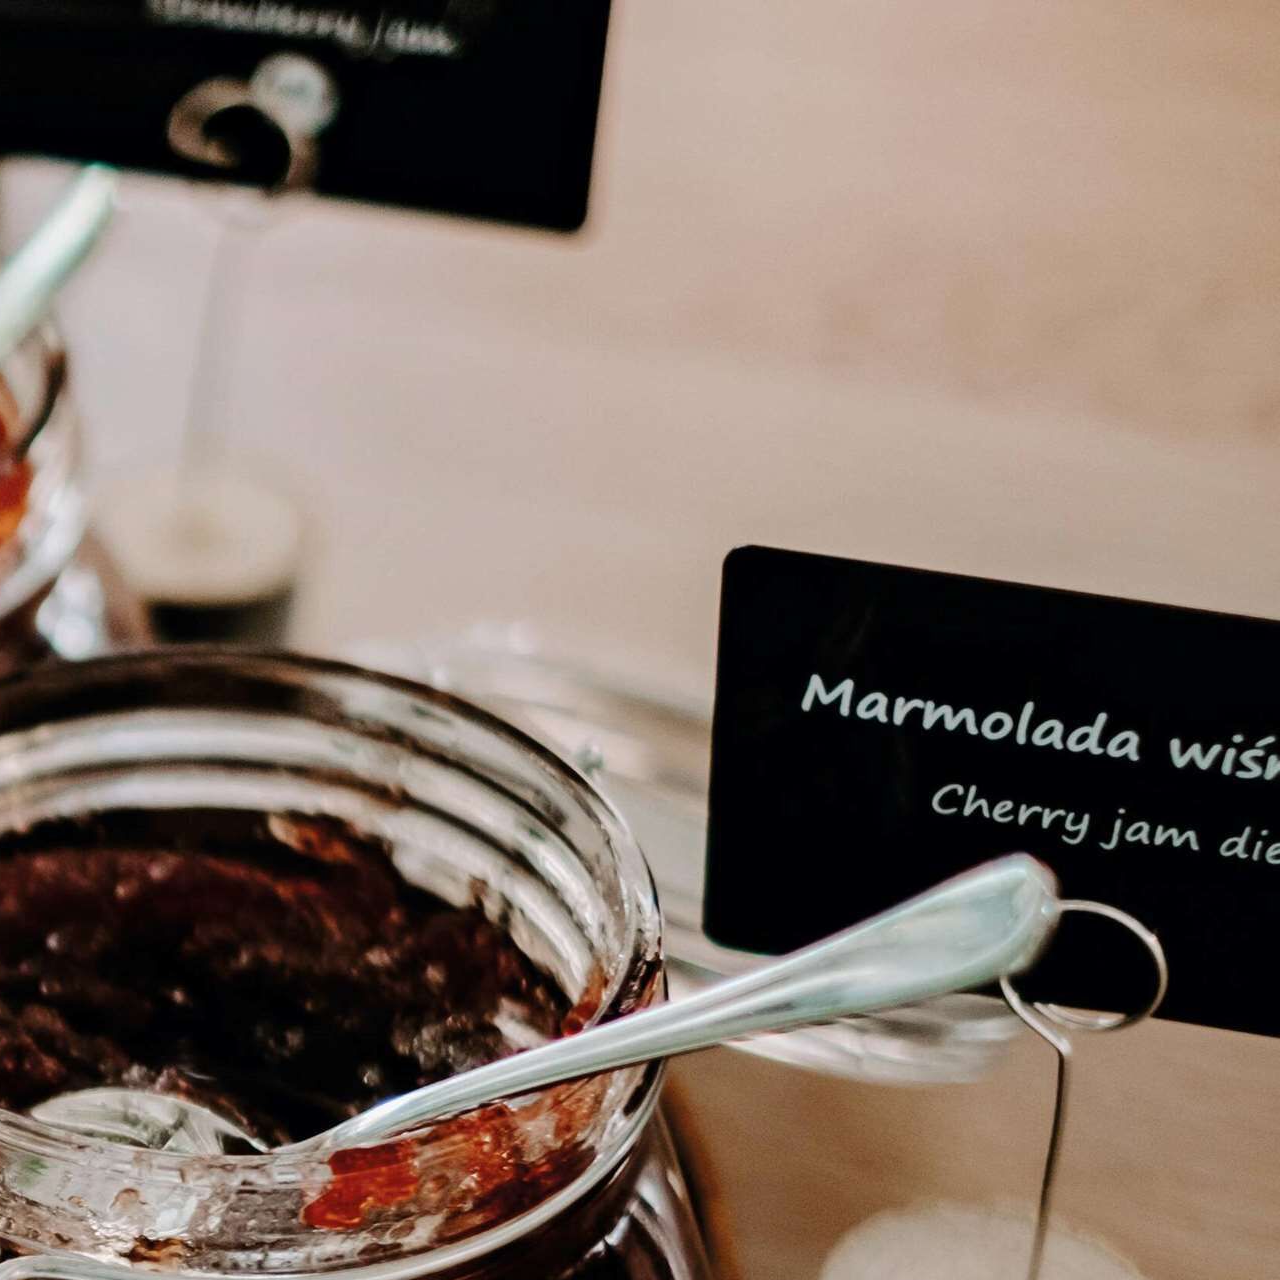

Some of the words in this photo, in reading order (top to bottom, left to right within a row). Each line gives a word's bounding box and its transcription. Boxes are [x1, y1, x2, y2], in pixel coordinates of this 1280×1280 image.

[801, 673, 1140, 762] Marmolada
[931, 783, 1091, 845] Cherry
[1098, 807, 1200, 851] jam
